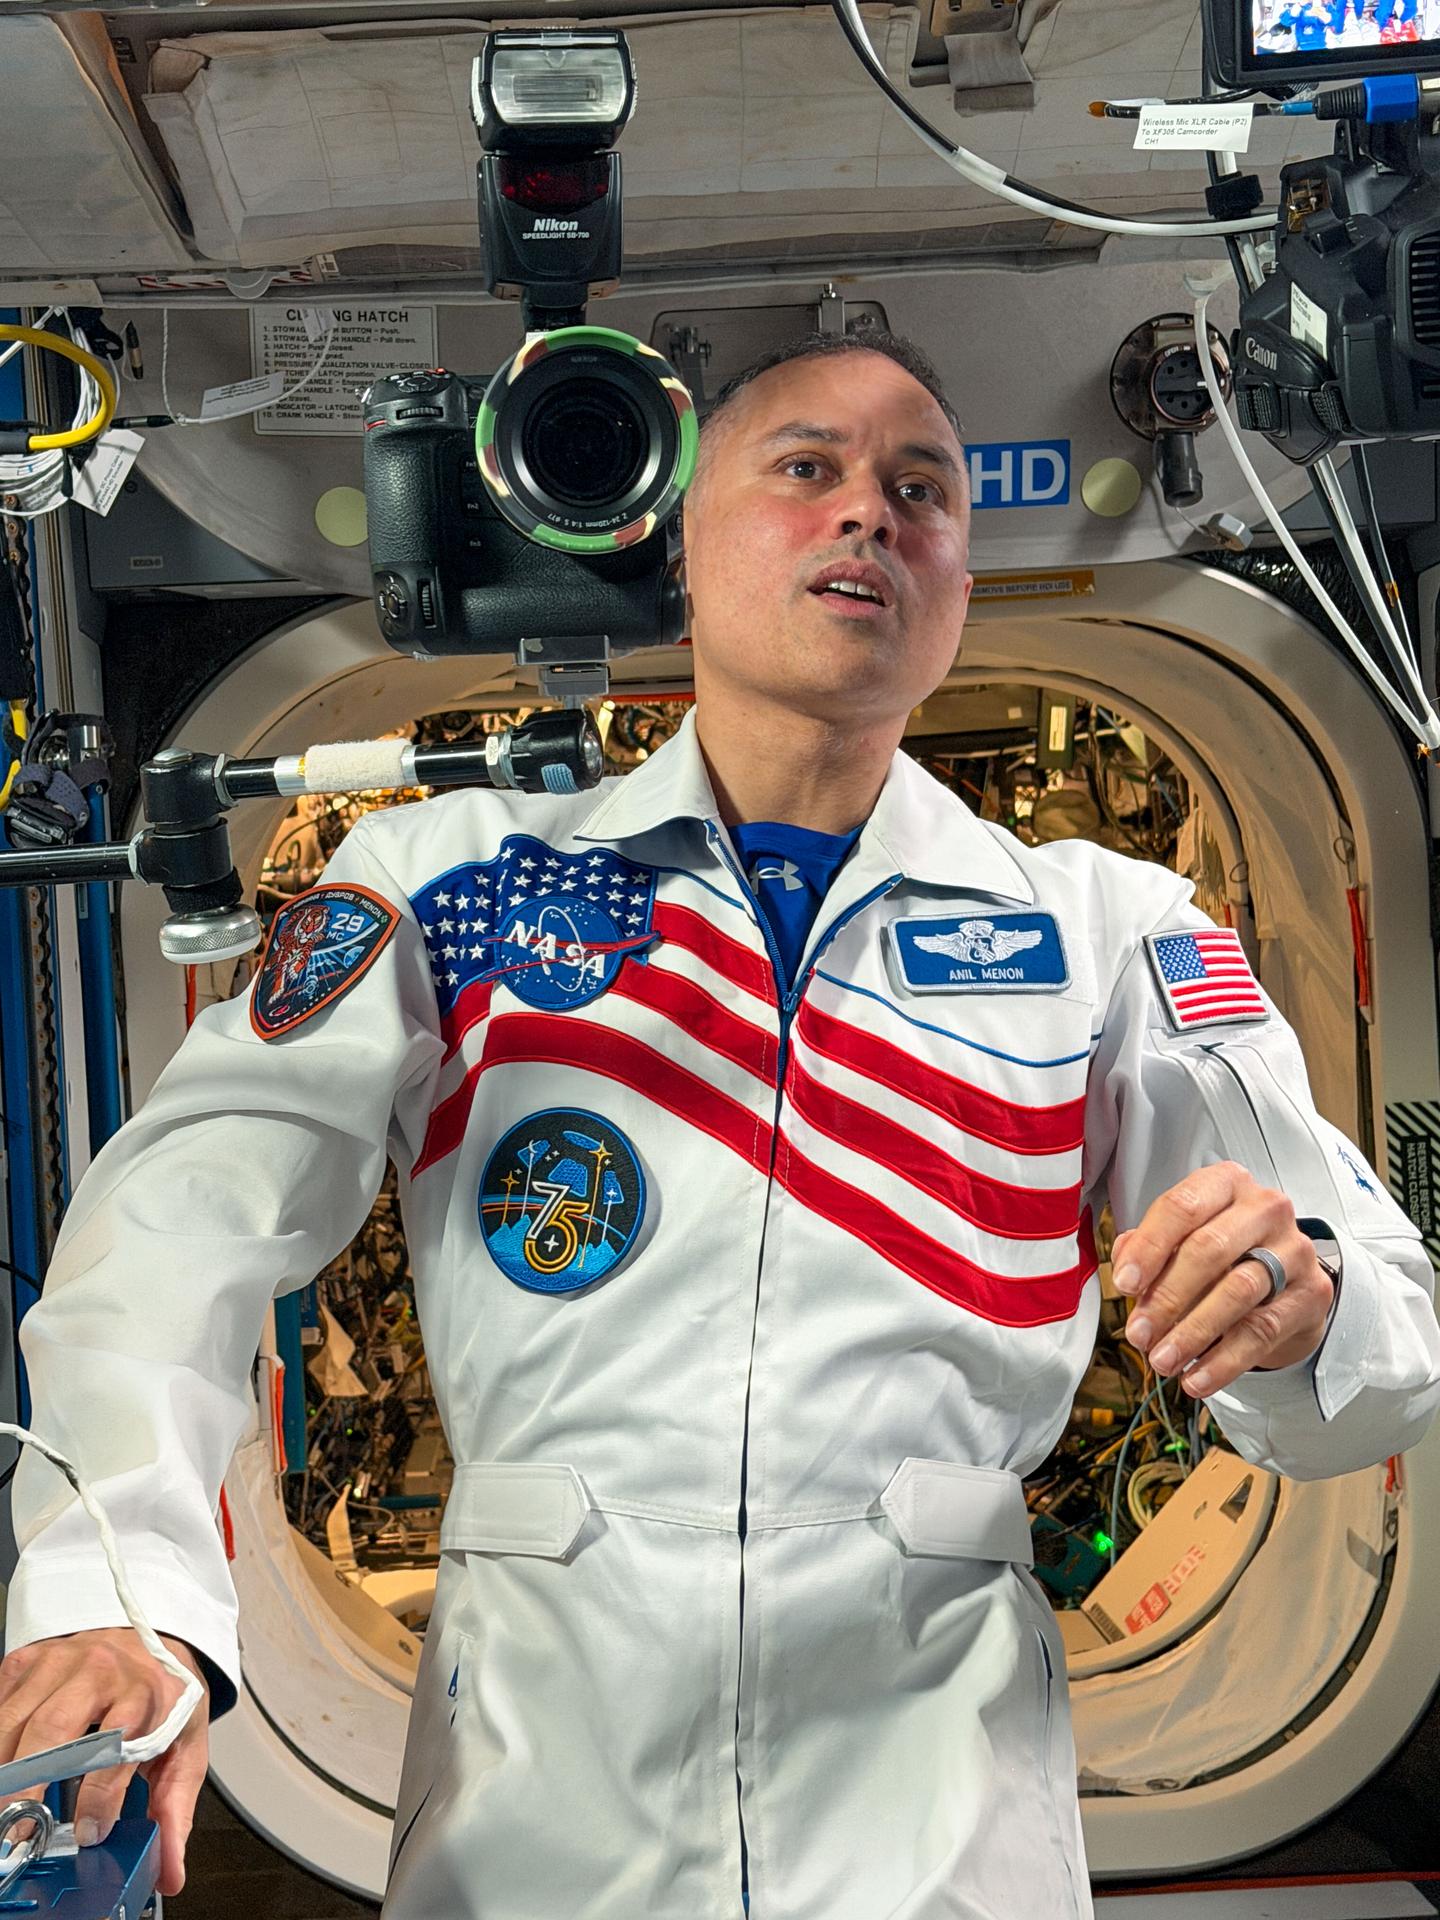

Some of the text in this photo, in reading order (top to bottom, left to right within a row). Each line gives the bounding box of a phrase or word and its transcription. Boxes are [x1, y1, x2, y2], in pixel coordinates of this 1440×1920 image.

[1232, 118, 1248, 126] (P2)
[534, 219, 578, 231] Nikon
[522, 232, 565, 240] SPEEDLIGHT
[286, 309, 409, 323] CLNG HATCH
[1246, 337, 1277, 371] Canon
[971, 448, 1066, 503] HD
[359, 898, 382, 918] MENON
[331, 913, 364, 932] 29
[504, 920, 606, 979] NASA
[949, 967, 1024, 980] ANIL MENON
[1407, 1142, 1421, 1229] HATCH CLOSUR
[1417, 1142, 1432, 1232] REMOVE BEFORE
[524, 1181, 590, 1273] 75
